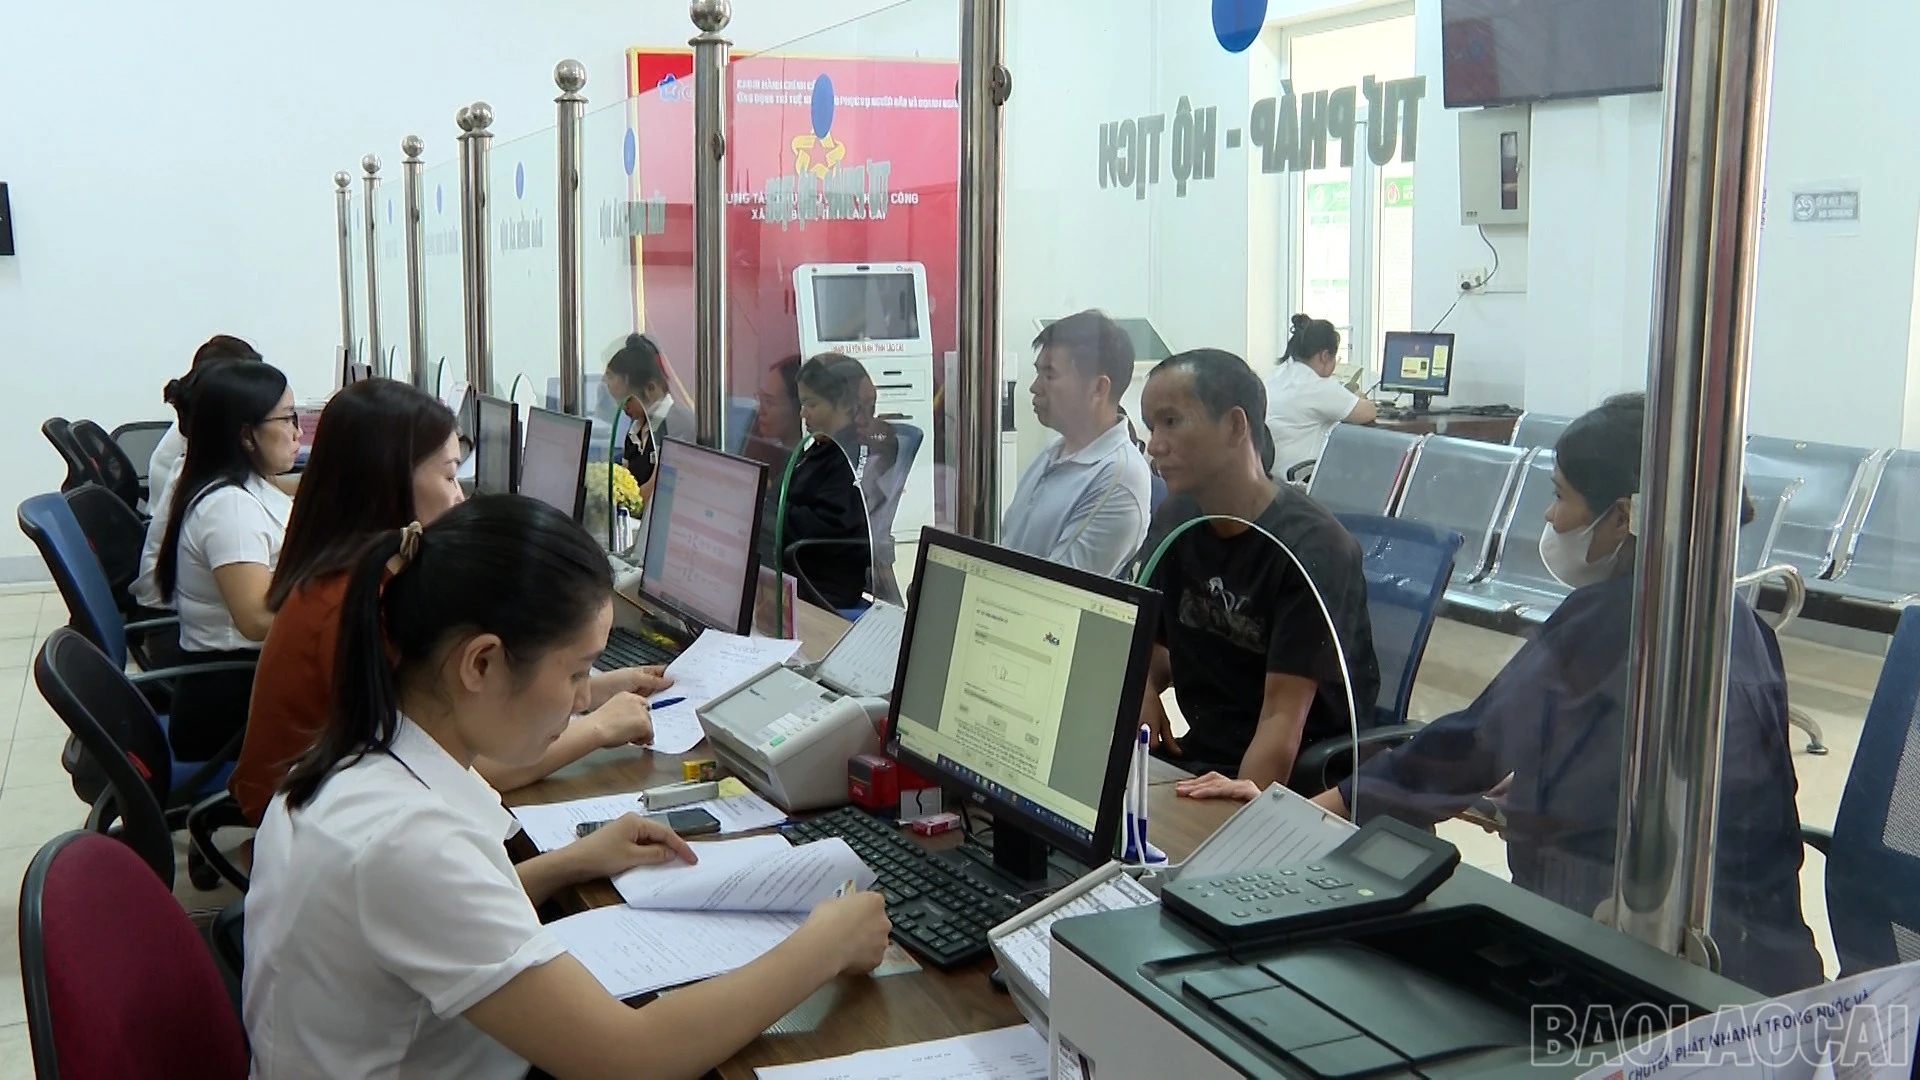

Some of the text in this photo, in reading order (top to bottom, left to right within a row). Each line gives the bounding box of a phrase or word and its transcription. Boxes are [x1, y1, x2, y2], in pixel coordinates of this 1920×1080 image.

[891, 191, 919, 205] CÔNG
[1675, 1036, 1706, 1062] PHÁT
[1709, 1023, 1762, 1047] NHANH
[1765, 1012, 1813, 1033] TRONG
[1816, 996, 1850, 1019] NƯỚC
[1853, 989, 1869, 1005] VÀ
